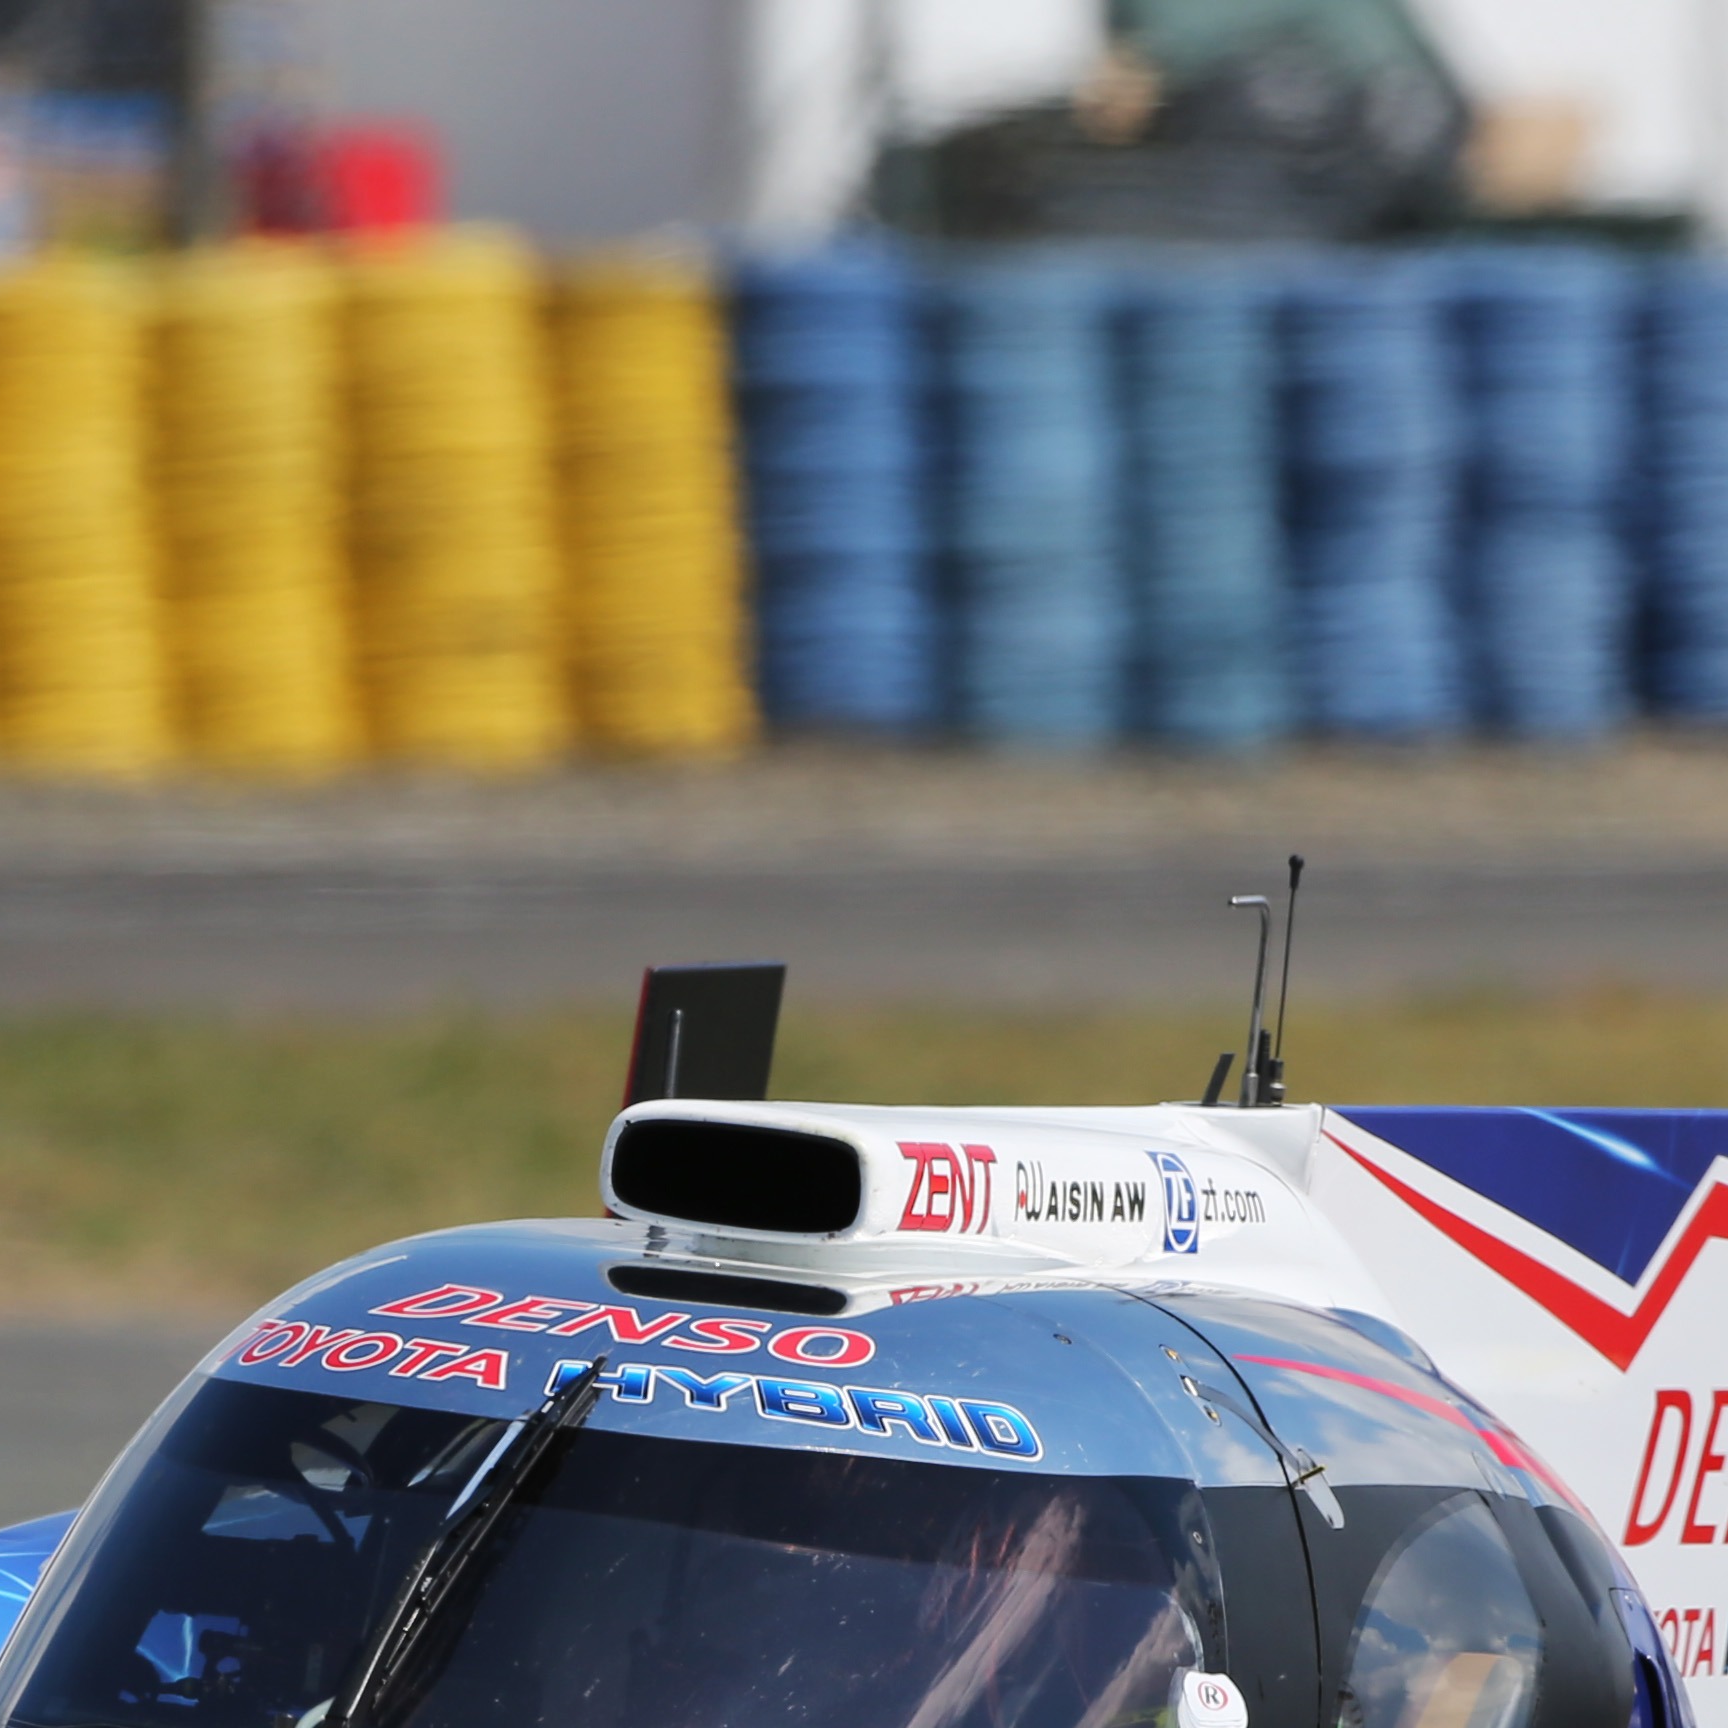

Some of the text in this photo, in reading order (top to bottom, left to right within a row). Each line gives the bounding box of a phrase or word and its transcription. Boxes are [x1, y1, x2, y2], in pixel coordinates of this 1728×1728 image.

[896, 1141, 998, 1235] ZENT
[1045, 1181, 1103, 1222] AISIN
[1110, 1181, 1145, 1222] AW
[1201, 1178, 1265, 1223] zf.com
[369, 1282, 876, 1368] DENSO
[220, 1318, 1044, 1462] TOYOTA HYBRID
